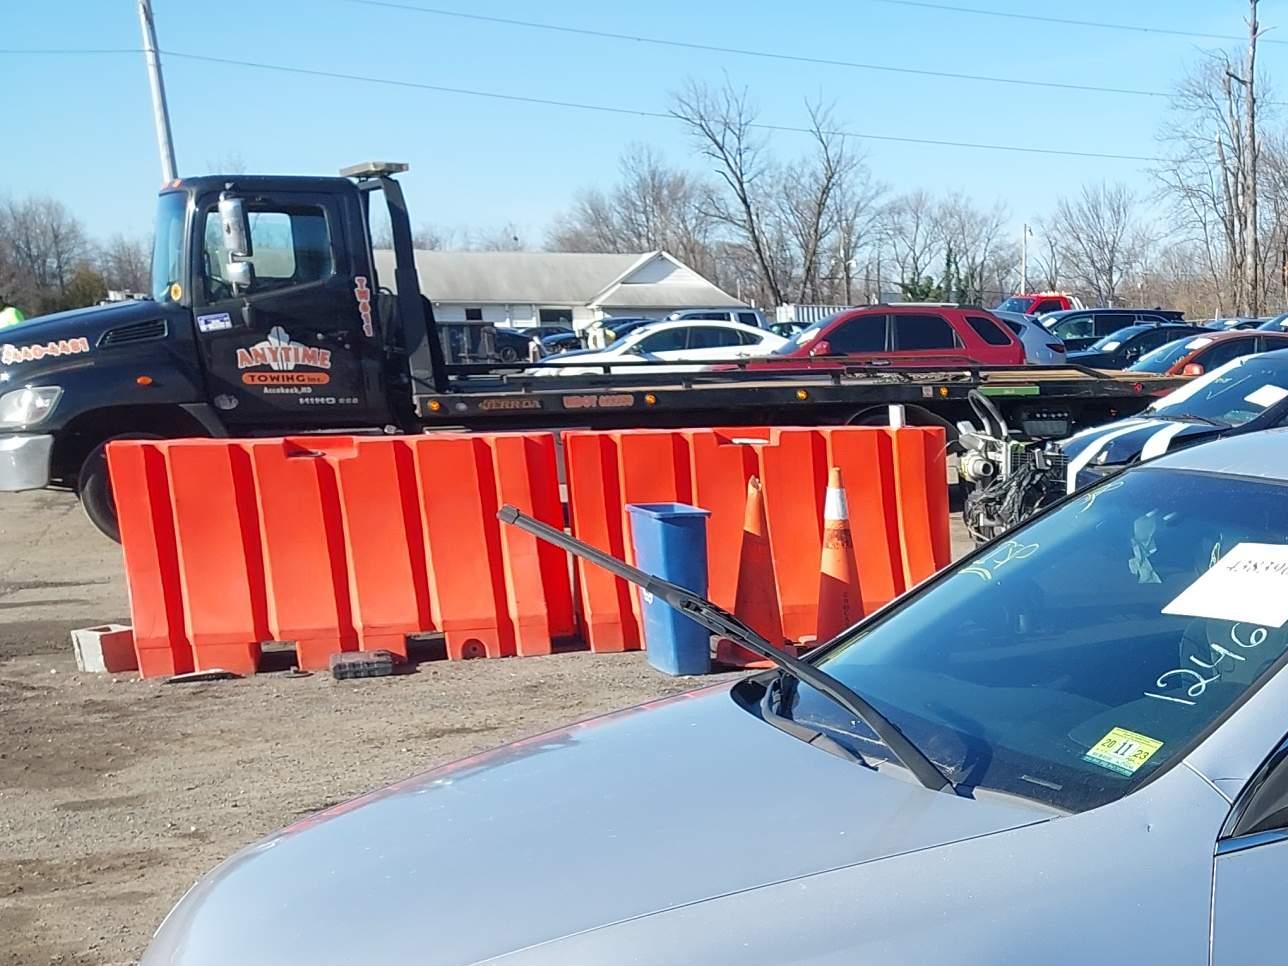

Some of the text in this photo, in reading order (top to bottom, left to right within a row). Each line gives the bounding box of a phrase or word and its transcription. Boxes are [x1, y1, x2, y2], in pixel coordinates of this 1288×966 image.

[236, 346, 332, 369] ANYTIME
[249, 374, 306, 383] TOWING
[1101, 738, 1149, 760] 20 11 23
